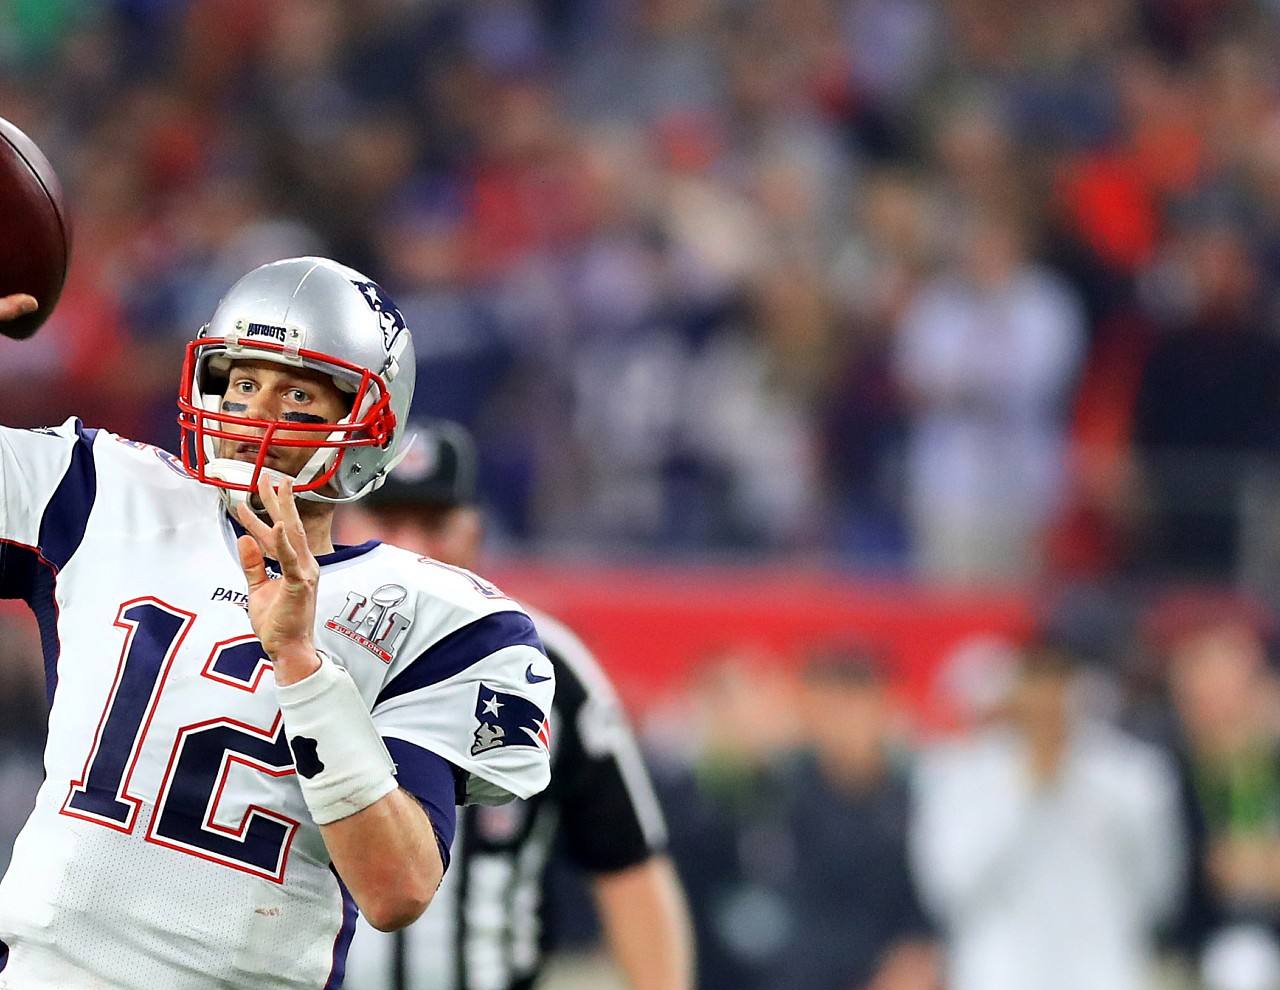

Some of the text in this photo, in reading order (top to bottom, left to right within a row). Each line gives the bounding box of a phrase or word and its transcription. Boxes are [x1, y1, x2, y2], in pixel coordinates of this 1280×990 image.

[246, 322, 287, 343] PATRIOTS
[210, 586, 249, 603] PATR
[334, 624, 384, 656] SUPER BOWL
[60, 595, 300, 884] 12
